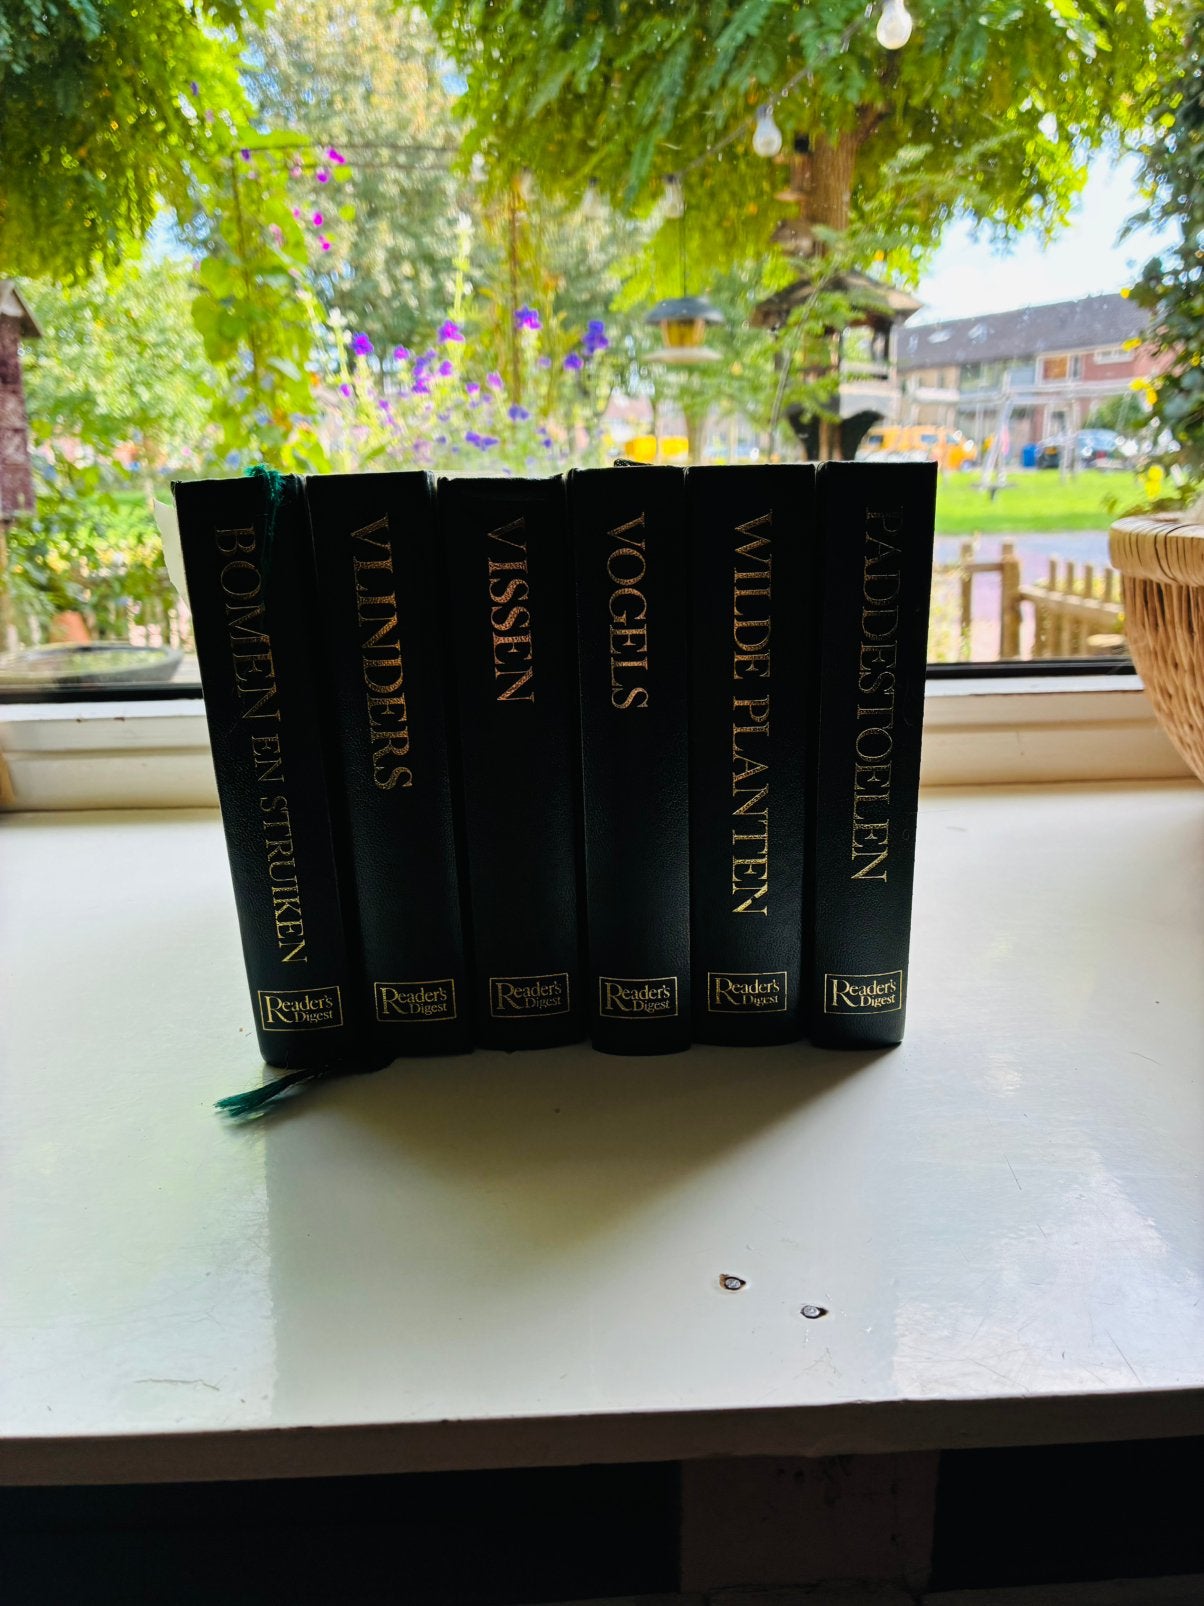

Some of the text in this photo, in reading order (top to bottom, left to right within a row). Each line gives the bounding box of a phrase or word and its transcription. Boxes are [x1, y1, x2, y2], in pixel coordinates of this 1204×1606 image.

[487, 516, 535, 703] VISSEN
[606, 511, 649, 709] VOGELS
[350, 512, 414, 790] VLINDERS
[732, 508, 772, 907] WILDE PLANTEN
[850, 505, 903, 883] PADDESTOELEN
[215, 525, 308, 963] BOMEN EN STRUIKEN
[380, 987, 447, 1014] Reader's
[496, 981, 562, 1010] Reader's
[525, 997, 561, 1009] Digest
[605, 982, 670, 1011] Reader's
[715, 978, 780, 1006] Reader's
[742, 994, 779, 1007] Digest
[831, 979, 896, 1007] Reader's
[860, 993, 896, 1007] Digest
[264, 995, 333, 1023] Reader's
[294, 1011, 333, 1023] Digest
[410, 1002, 447, 1015] Digest
[632, 1000, 670, 1013] Digest
